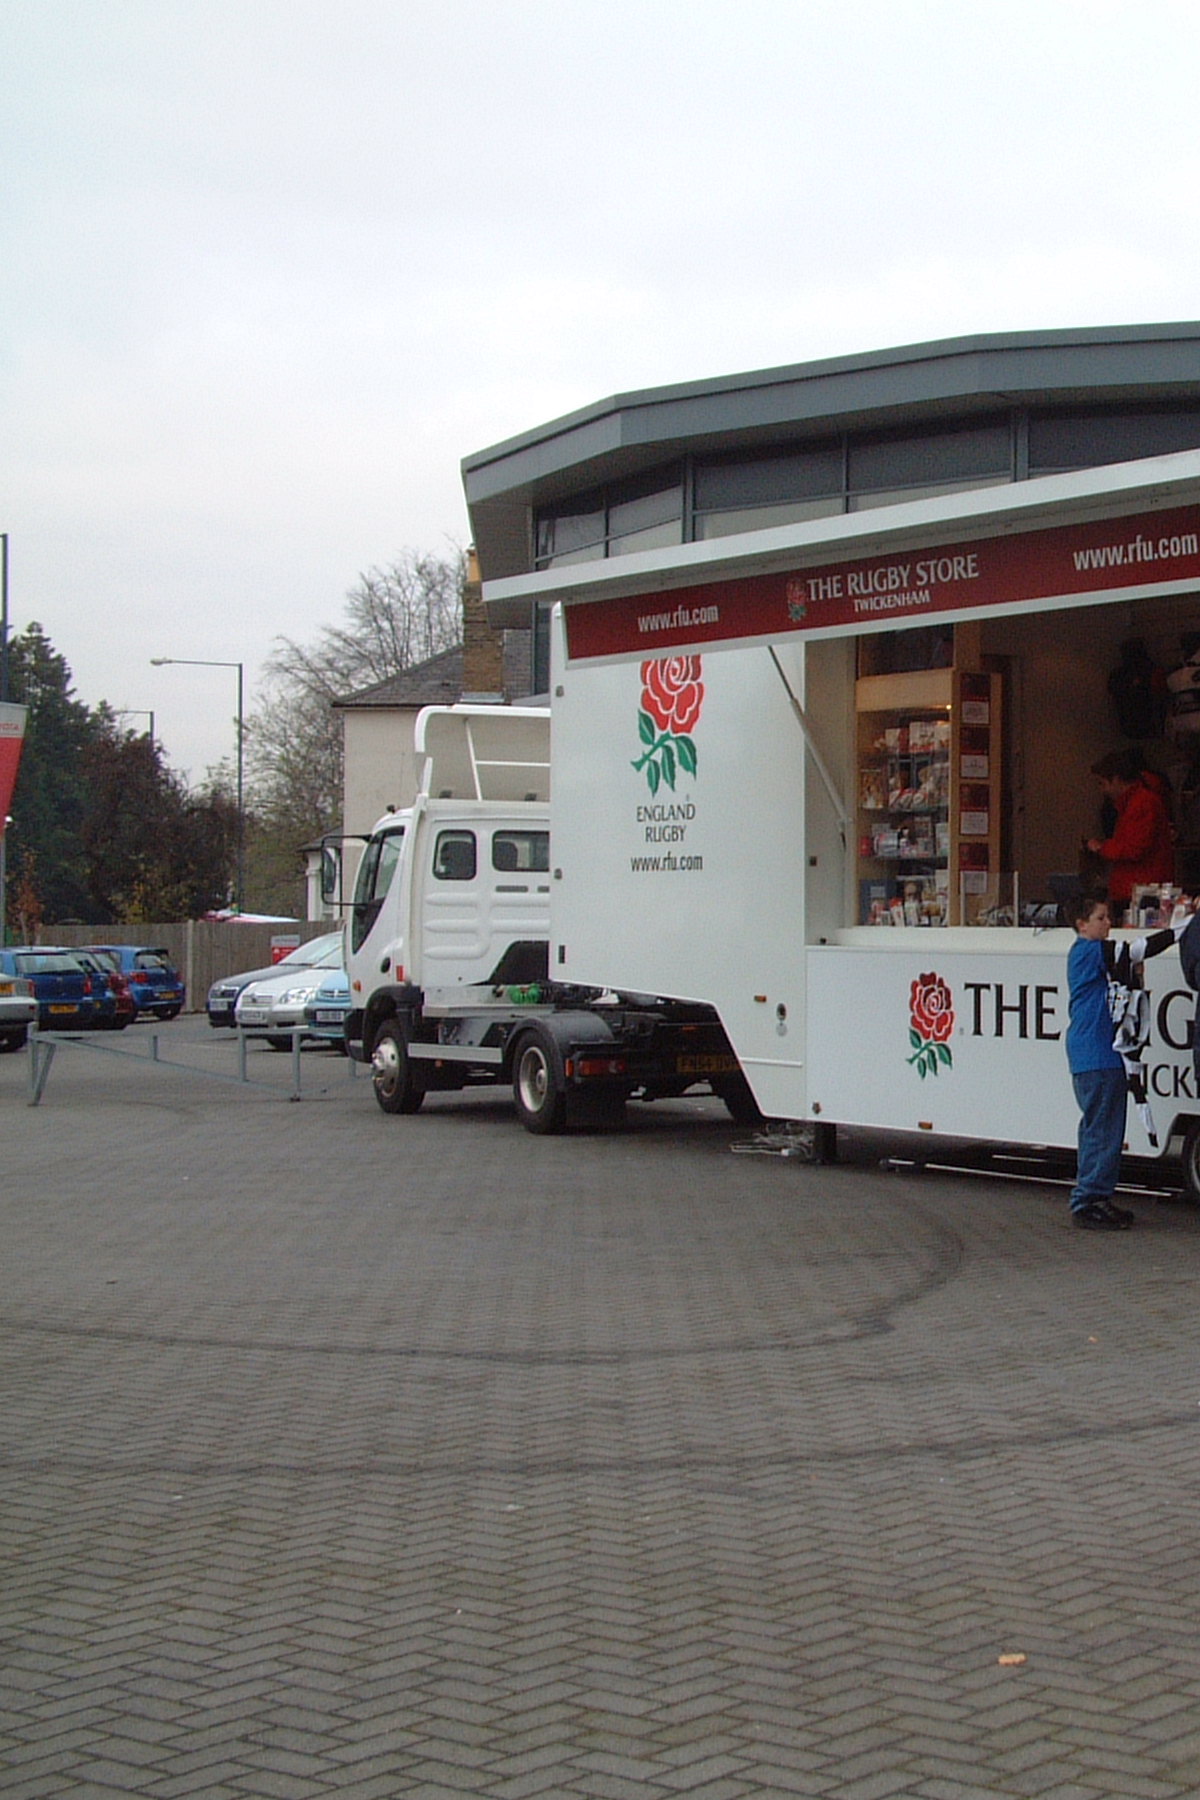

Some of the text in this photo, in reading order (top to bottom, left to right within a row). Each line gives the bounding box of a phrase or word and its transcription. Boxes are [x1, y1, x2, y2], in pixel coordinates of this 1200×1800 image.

[1073, 533, 1199, 571] www.rfu.com
[807, 554, 979, 600] THE RUGBY STORE
[854, 589, 931, 613] TWICKENHAM
[637, 604, 719, 632] www.rfu.com
[636, 803, 696, 822] ENGLAND
[645, 825, 687, 842] RUGBY
[631, 851, 703, 871] www.rfu.com
[964, 983, 1061, 1040] THE
